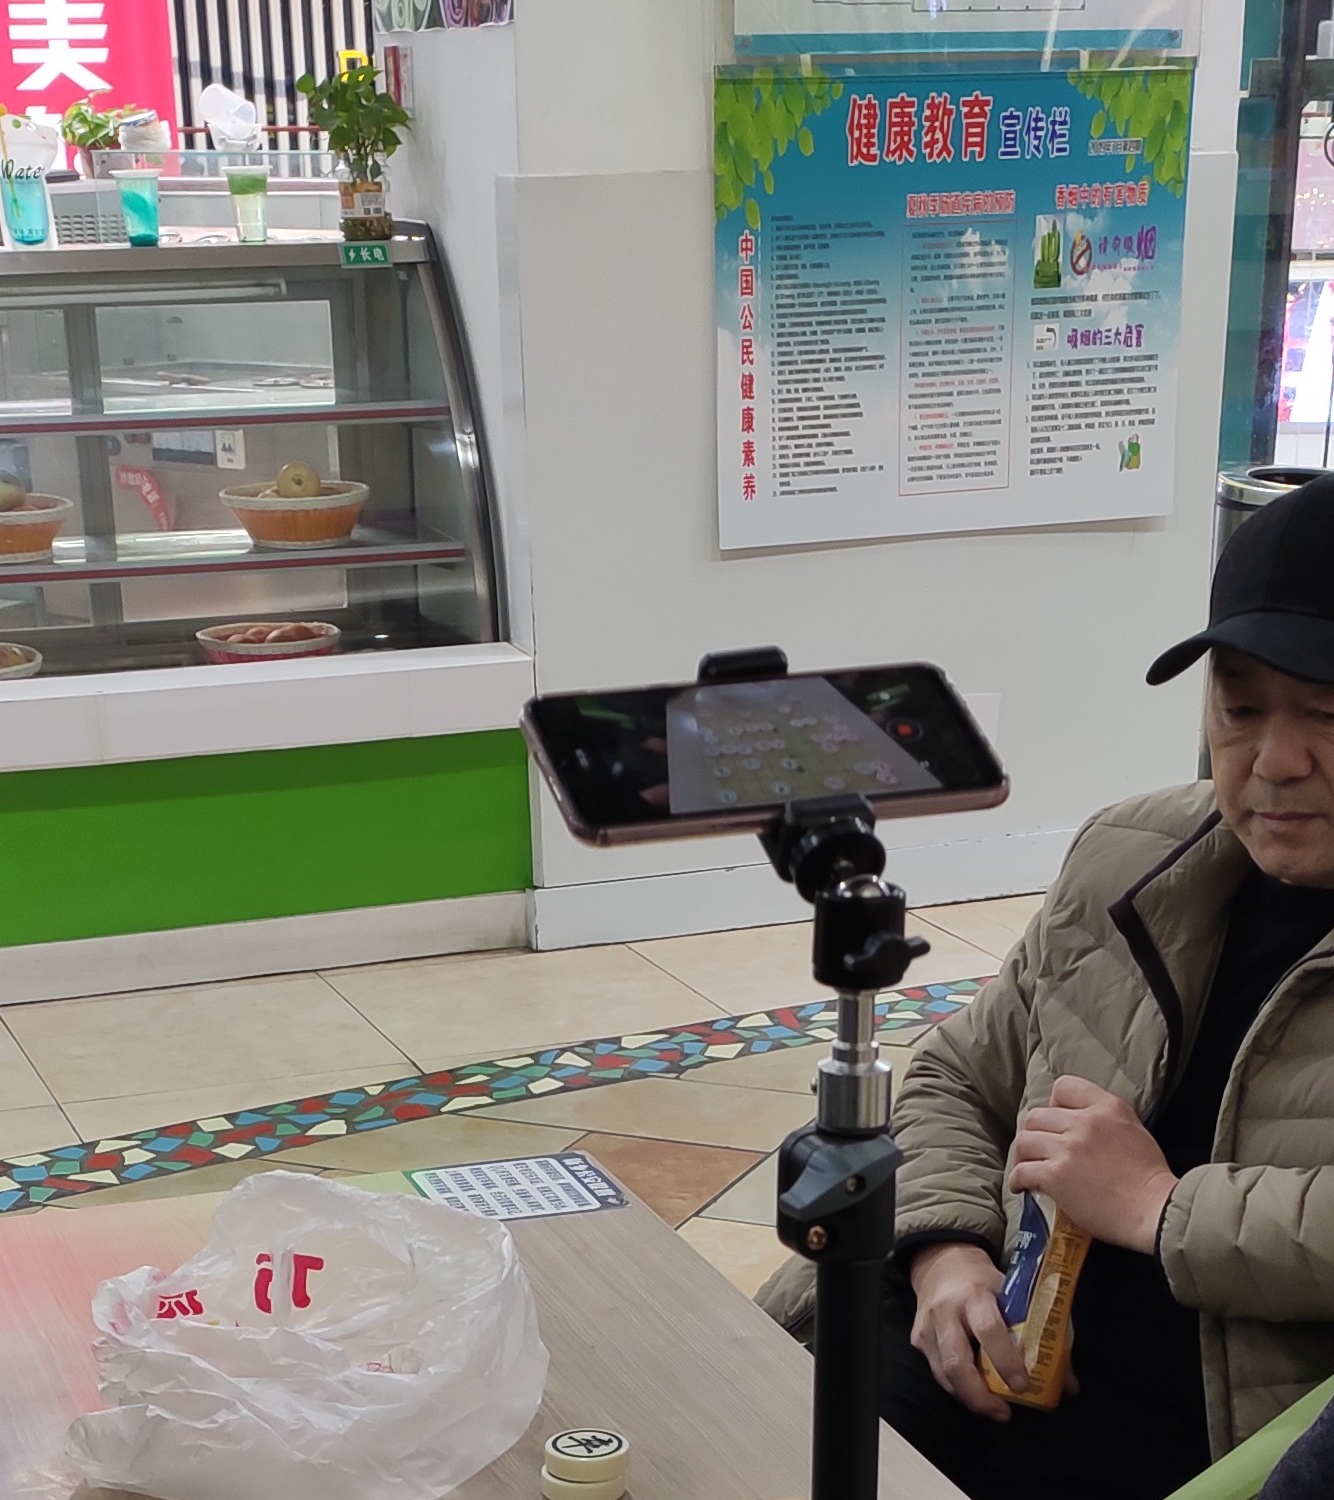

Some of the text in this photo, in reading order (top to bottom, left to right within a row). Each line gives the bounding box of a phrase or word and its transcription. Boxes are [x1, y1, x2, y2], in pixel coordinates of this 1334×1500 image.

[847, 91, 1070, 166] 健康教育 宣传栏
[1054, 181, 1149, 210] 香烟中的有害物质
[1067, 323, 1144, 349] 吸烟的三大危害
[738, 230, 758, 501] 中国公民健康素养
